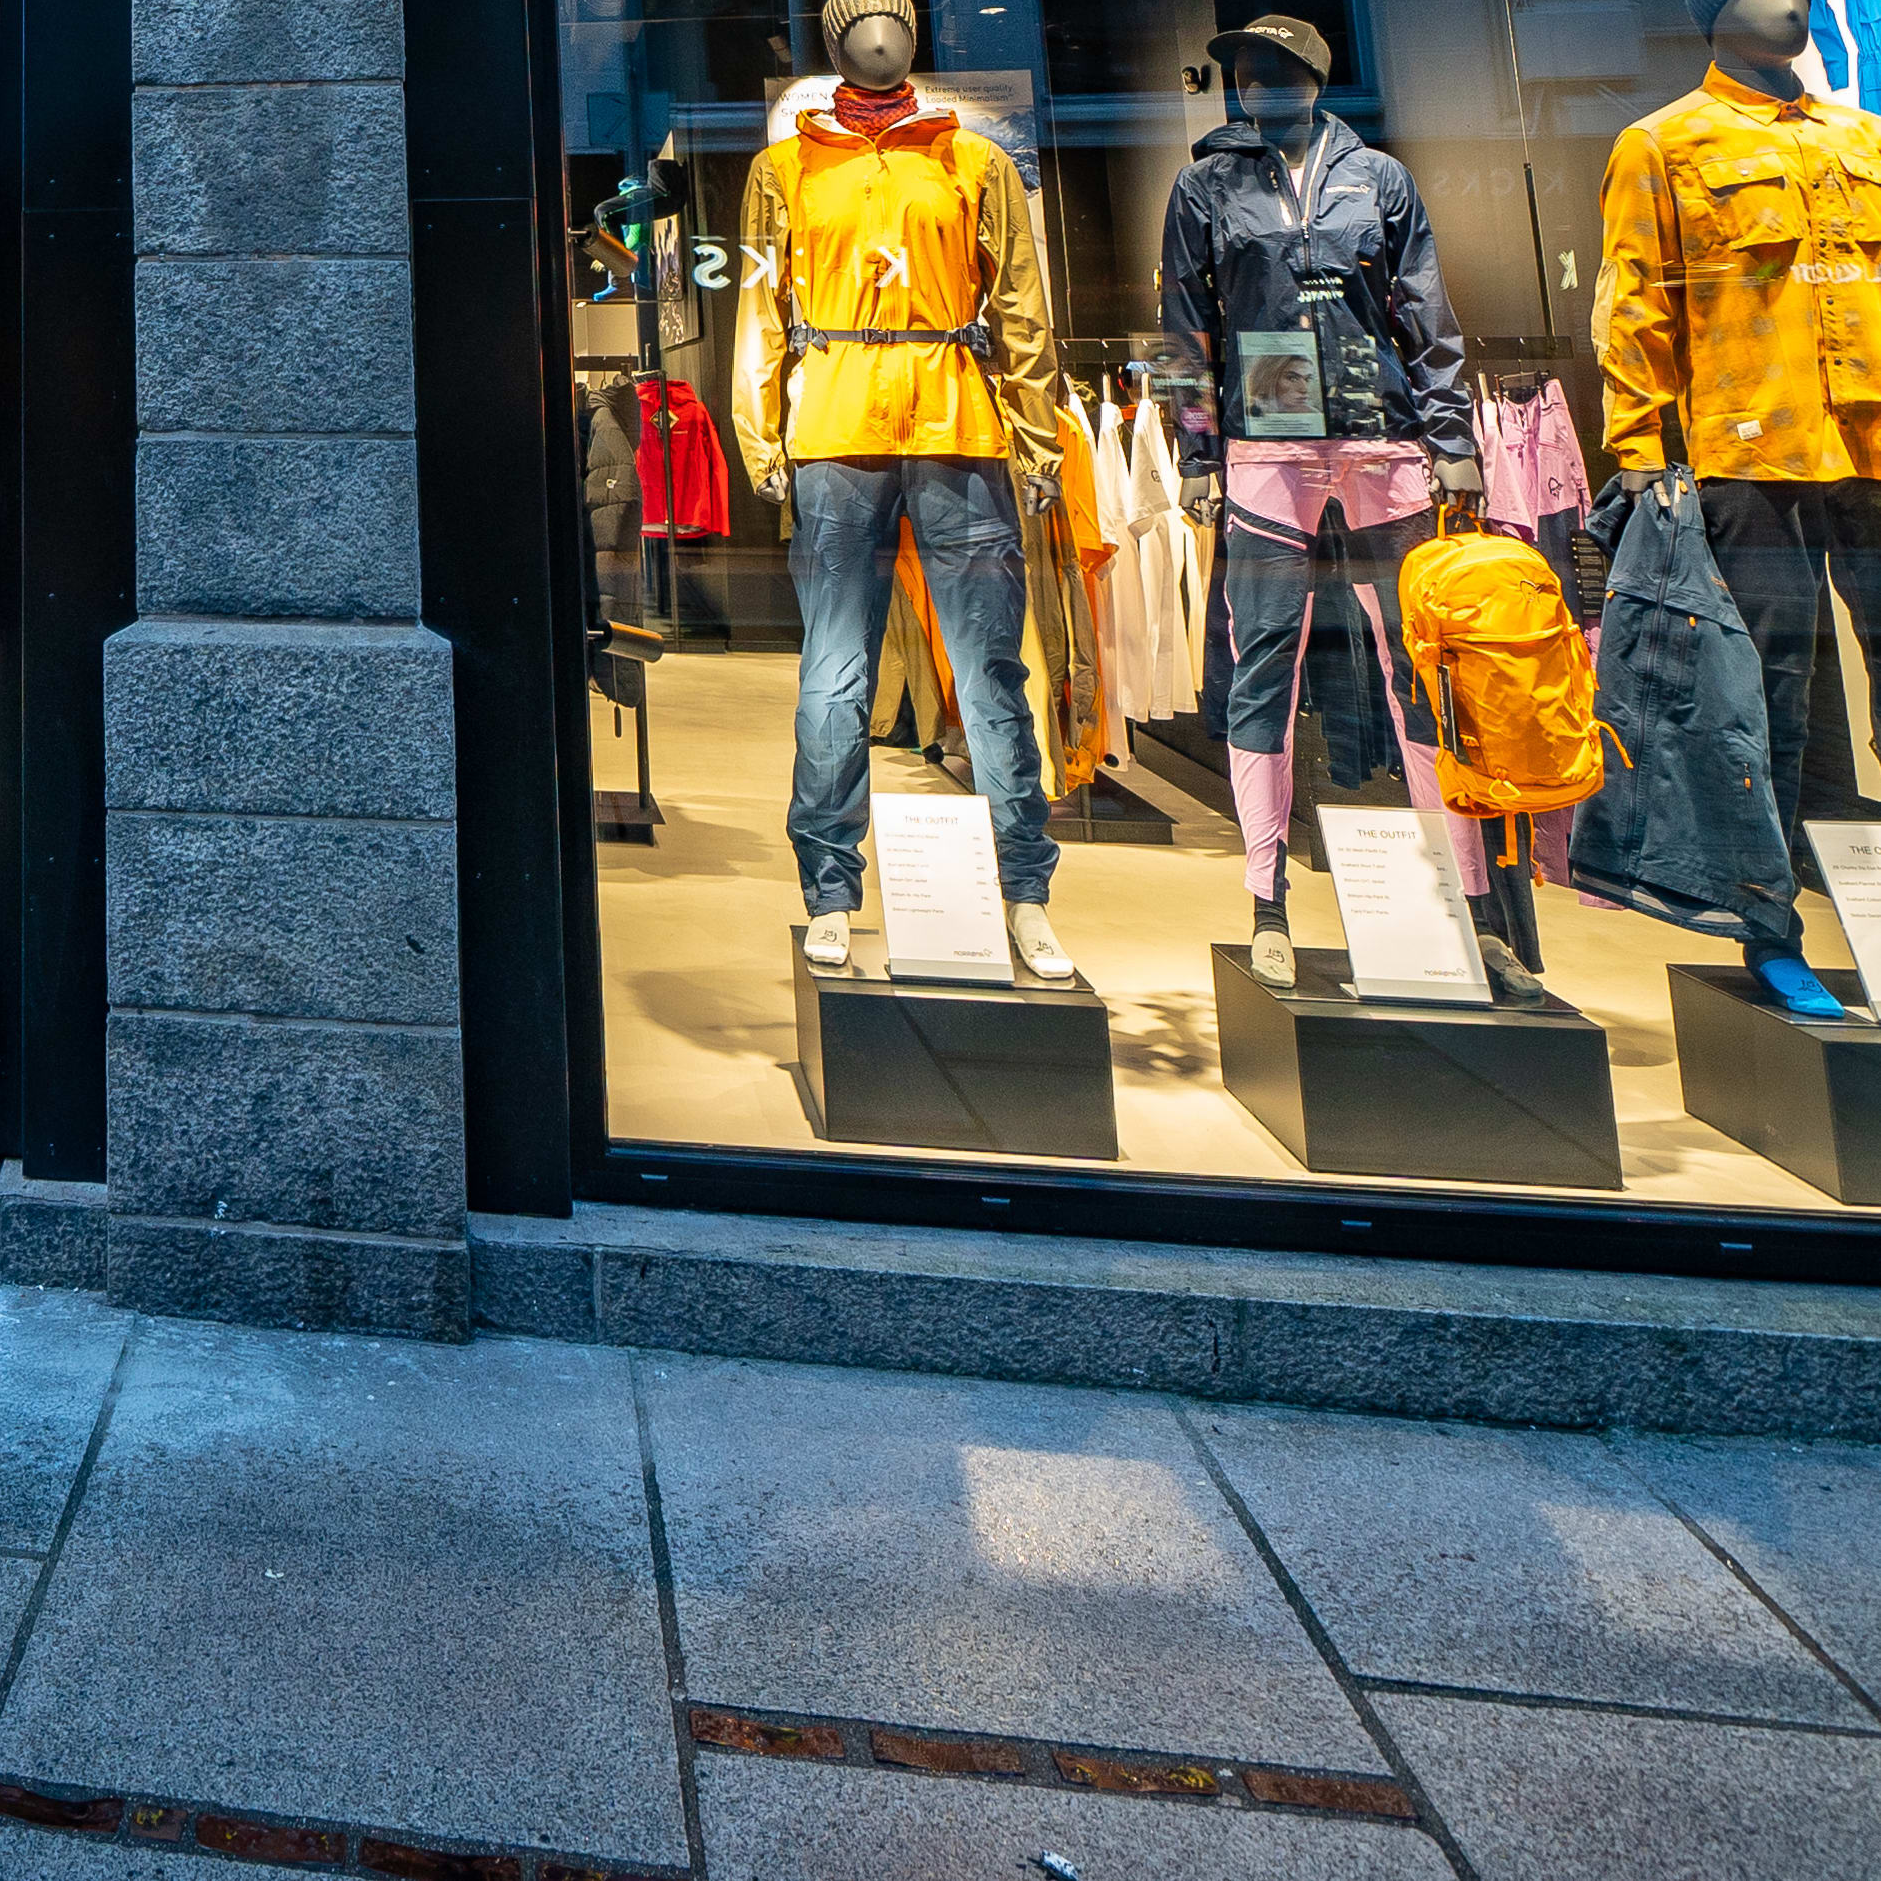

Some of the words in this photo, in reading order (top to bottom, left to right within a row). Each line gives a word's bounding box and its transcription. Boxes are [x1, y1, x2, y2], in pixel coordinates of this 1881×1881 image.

[925, 85, 960, 94] Extreme
[983, 84, 1014, 95] quality
[925, 816, 959, 825] OUTFIT
[1357, 829, 1378, 839] THE
[1380, 830, 1417, 840] OUTFIT
[1849, 845, 1873, 856] THE
